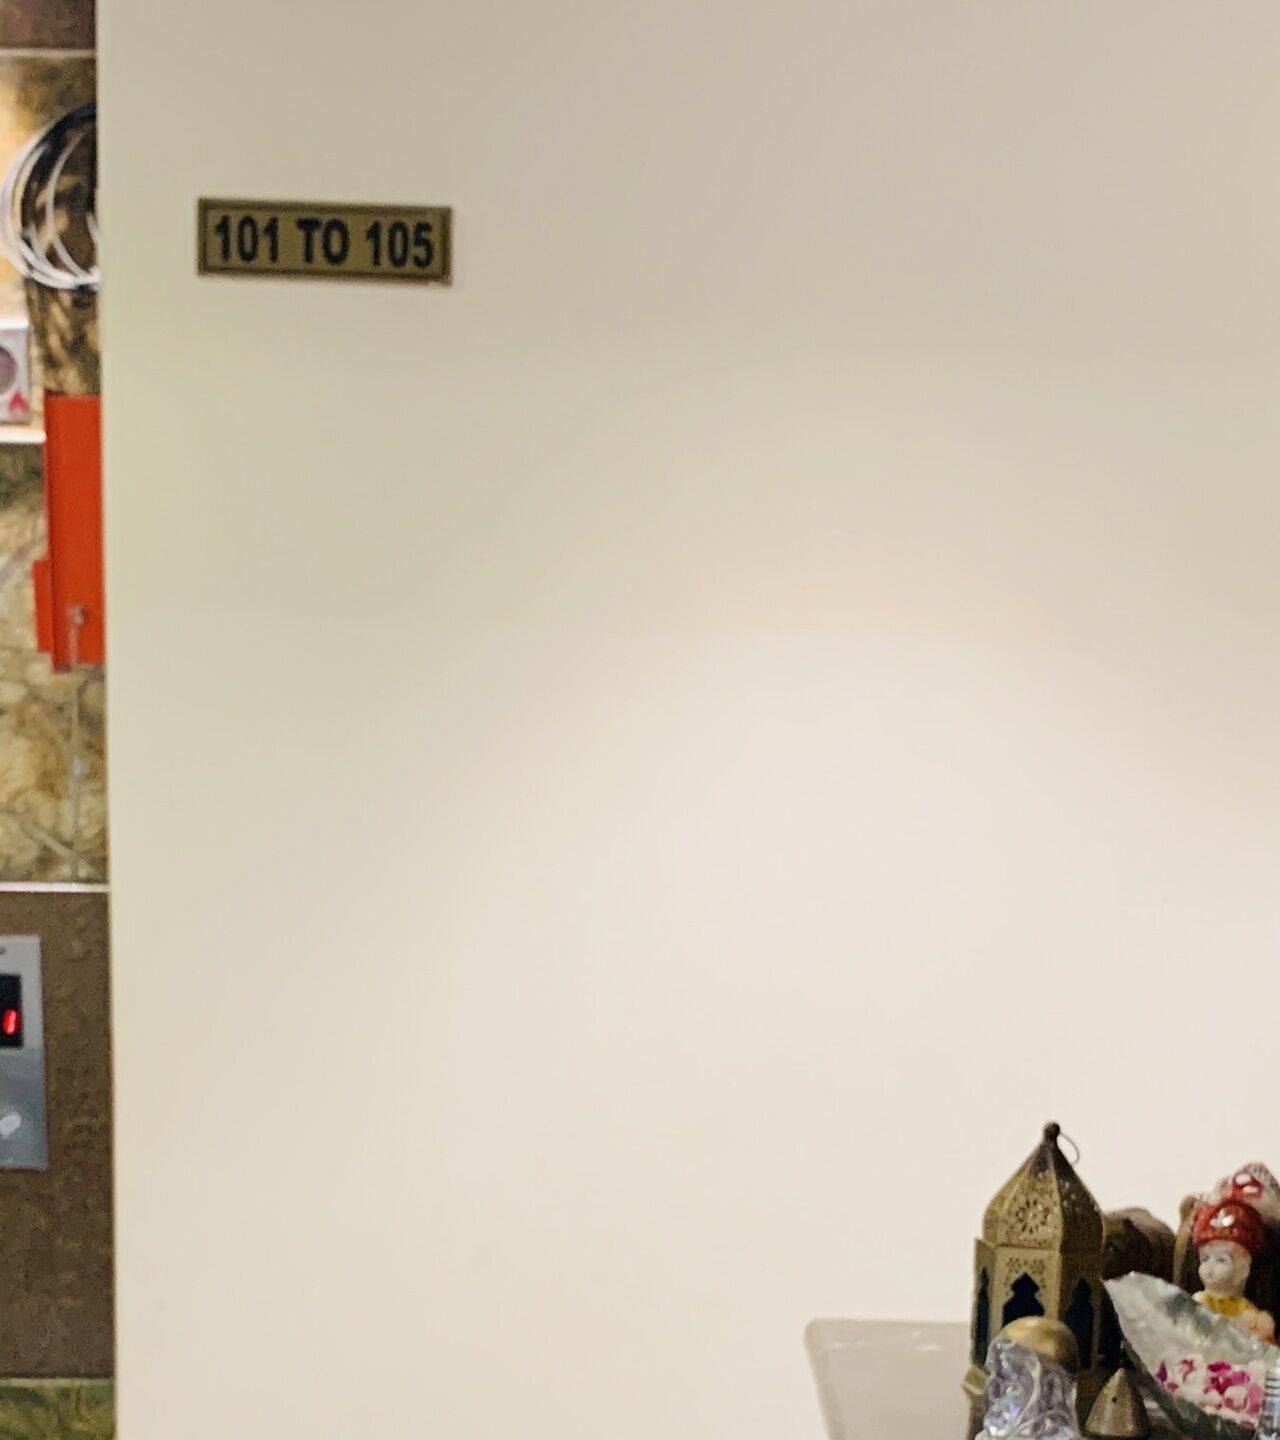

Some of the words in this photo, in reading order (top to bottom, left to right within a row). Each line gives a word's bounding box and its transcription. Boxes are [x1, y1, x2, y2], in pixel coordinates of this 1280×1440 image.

[214, 215, 280, 263] 101
[295, 218, 350, 266] TO
[365, 220, 434, 269] 105
